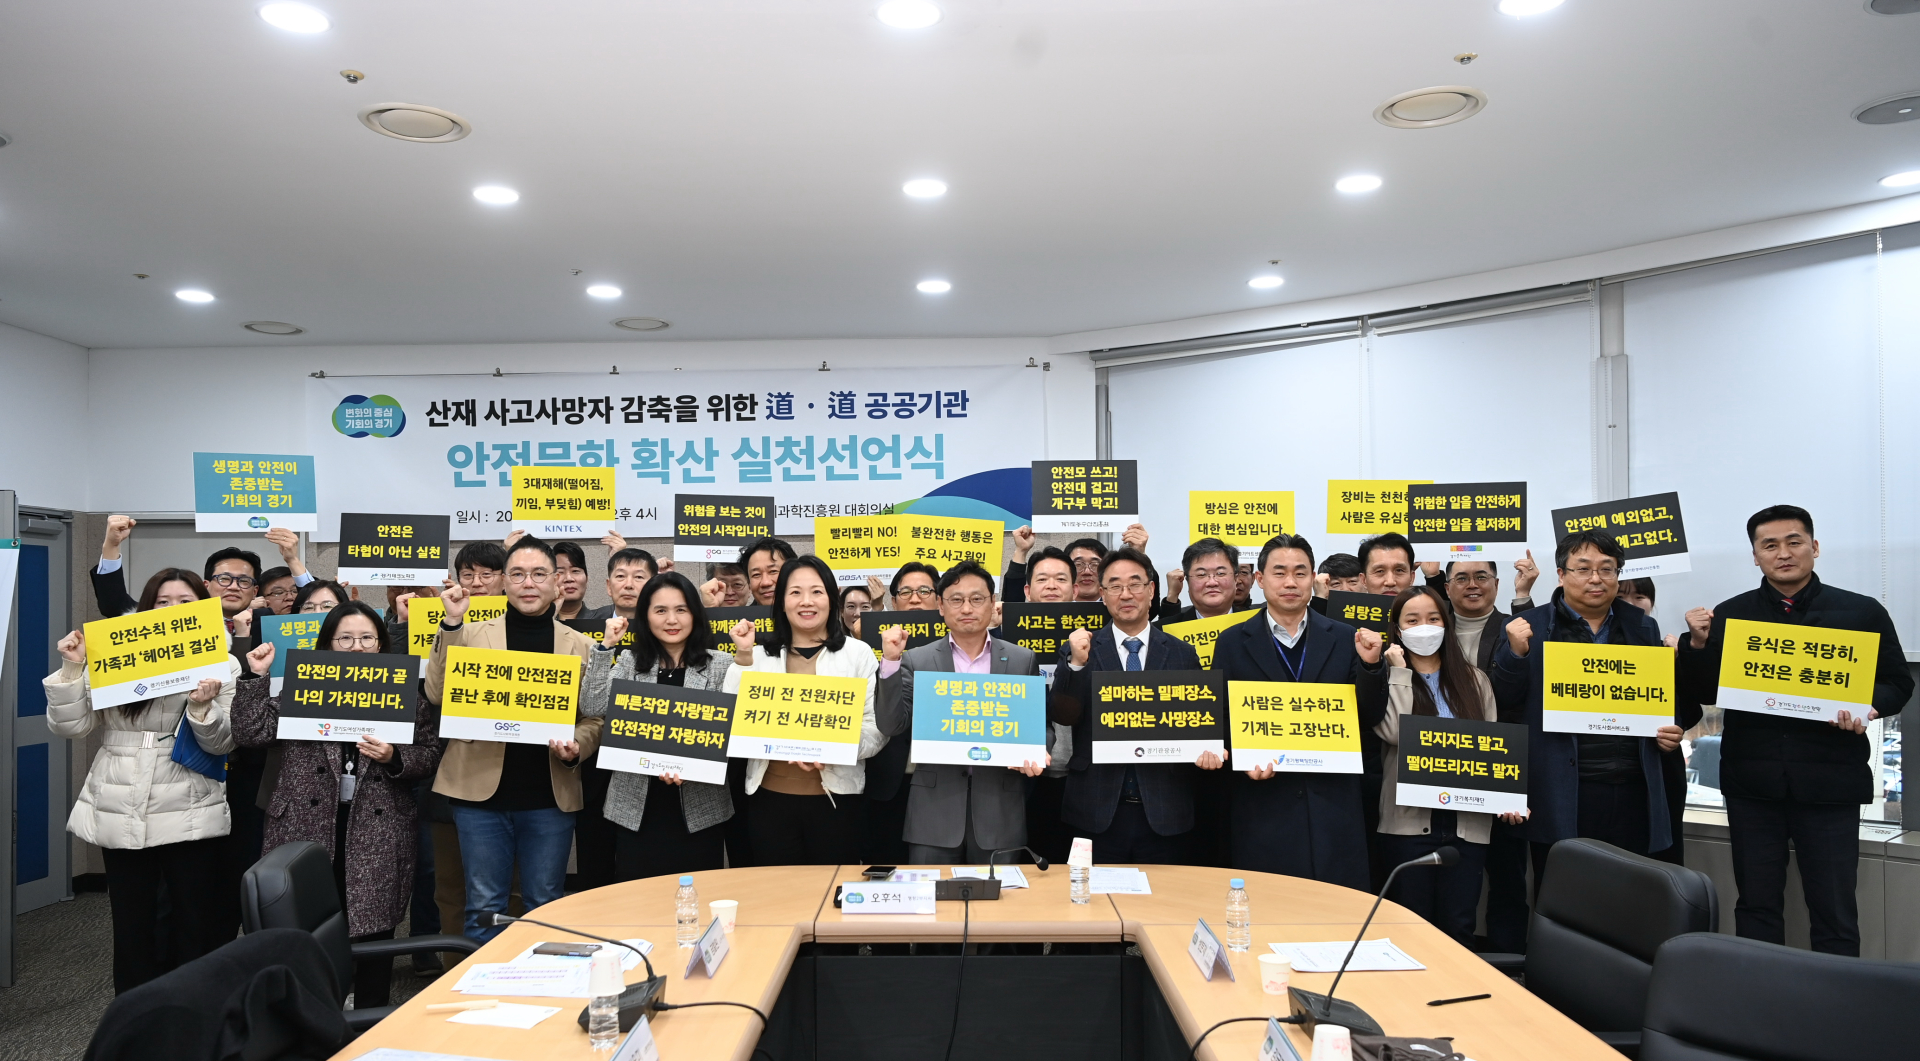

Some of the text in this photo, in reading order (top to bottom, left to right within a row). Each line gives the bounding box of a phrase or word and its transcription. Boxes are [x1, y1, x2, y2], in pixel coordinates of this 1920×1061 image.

[345, 407, 393, 418] 변화의 중심
[425, 399, 477, 428] 산재
[484, 396, 614, 426] 사고사망자
[620, 394, 700, 424] 감축을
[706, 392, 758, 422] 위한
[765, 391, 795, 421] 道
[827, 390, 857, 420] 道
[864, 389, 970, 419] 공공기관
[345, 418, 393, 429] 기회의 경기
[212, 459, 297, 475] 생명과 안전이
[630, 437, 719, 485] 확산
[731, 433, 945, 484] 실천선언식
[1051, 466, 1118, 479] 안전모 쓰고!
[230, 476, 283, 491] 존중받는
[523, 478, 603, 491] 3대재해(떨어짐,
[1051, 481, 1118, 494] 안전대 걸고!
[221, 493, 293, 508] 기회의 경기
[515, 498, 611, 511] 끼임, 부딪힘) 예방!
[1051, 497, 1118, 510] 개구부 막고!
[1341, 491, 1376, 504] 장비는
[1413, 494, 1521, 510] 위험한 일을 안전하게
[456, 510, 481, 523] 일시
[636, 507, 657, 520] 4시
[683, 504, 766, 519] 위험을 보는 것이
[845, 503, 895, 516] 대회의실
[1205, 502, 1278, 515] 방심은 안전에
[1340, 511, 1375, 524] 사람은
[1413, 517, 1521, 532] 안전한 일을 철저하게
[1565, 506, 1674, 533] 안전에 예외없고,
[377, 525, 414, 539] 안전은
[545, 525, 583, 533] KINTEX
[677, 523, 772, 538] 안전의 시작입니다.
[830, 526, 898, 540] 빨리빨리 NO!
[910, 526, 994, 544] 불완전한 행동은
[1198, 523, 1221, 535] 대한
[1615, 528, 1678, 548] 예고없다.
[347, 544, 441, 560] 타협이 아닌 실천
[828, 546, 901, 560] 안전하게 YES!
[914, 548, 986, 564] 주요 사고원인
[1342, 604, 1383, 622] 설탕은
[279, 620, 321, 636] 생명과
[1017, 614, 1104, 630] 사고는 한순간!
[109, 615, 202, 647] 안전수칙 위반,
[1746, 634, 1858, 664] 음식은 적당히,
[94, 655, 137, 675] 가족과
[1581, 656, 1637, 676] 안전에는
[296, 663, 408, 684] 안전의 가치가 곧
[452, 661, 573, 686] 시작 전에 안전점검
[1743, 661, 1851, 688] 안전은 충분히
[748, 685, 856, 706] 정비 전 전원차단
[933, 679, 1026, 699] 생명과 안전이
[1098, 684, 1217, 702] 설마하는 밀폐장소,
[1550, 682, 1668, 703] 베테랑이 없습니다.
[294, 691, 405, 710] 나의 가치입니다.
[449, 687, 571, 711] 끝난 후에 확인점검
[1241, 696, 1346, 714] 사람은 실수하고
[614, 693, 729, 722] 빠른작업 자랑말고
[950, 700, 1010, 718] 존중받는
[743, 710, 852, 731] 켜기 전 사람확인
[1100, 710, 1216, 728] 예외없는 사망장소
[610, 718, 725, 749] 안전작업 자랑하자
[940, 718, 1019, 737] 기회의 경기
[1241, 720, 1350, 739] 기계는 고장난다.
[1419, 731, 1508, 754] 던지지도 말고,
[1406, 755, 1520, 780] 떨어뜨리지도 말자
[1453, 795, 1485, 804] 경기복지재단
[871, 893, 901, 903] 오후석
